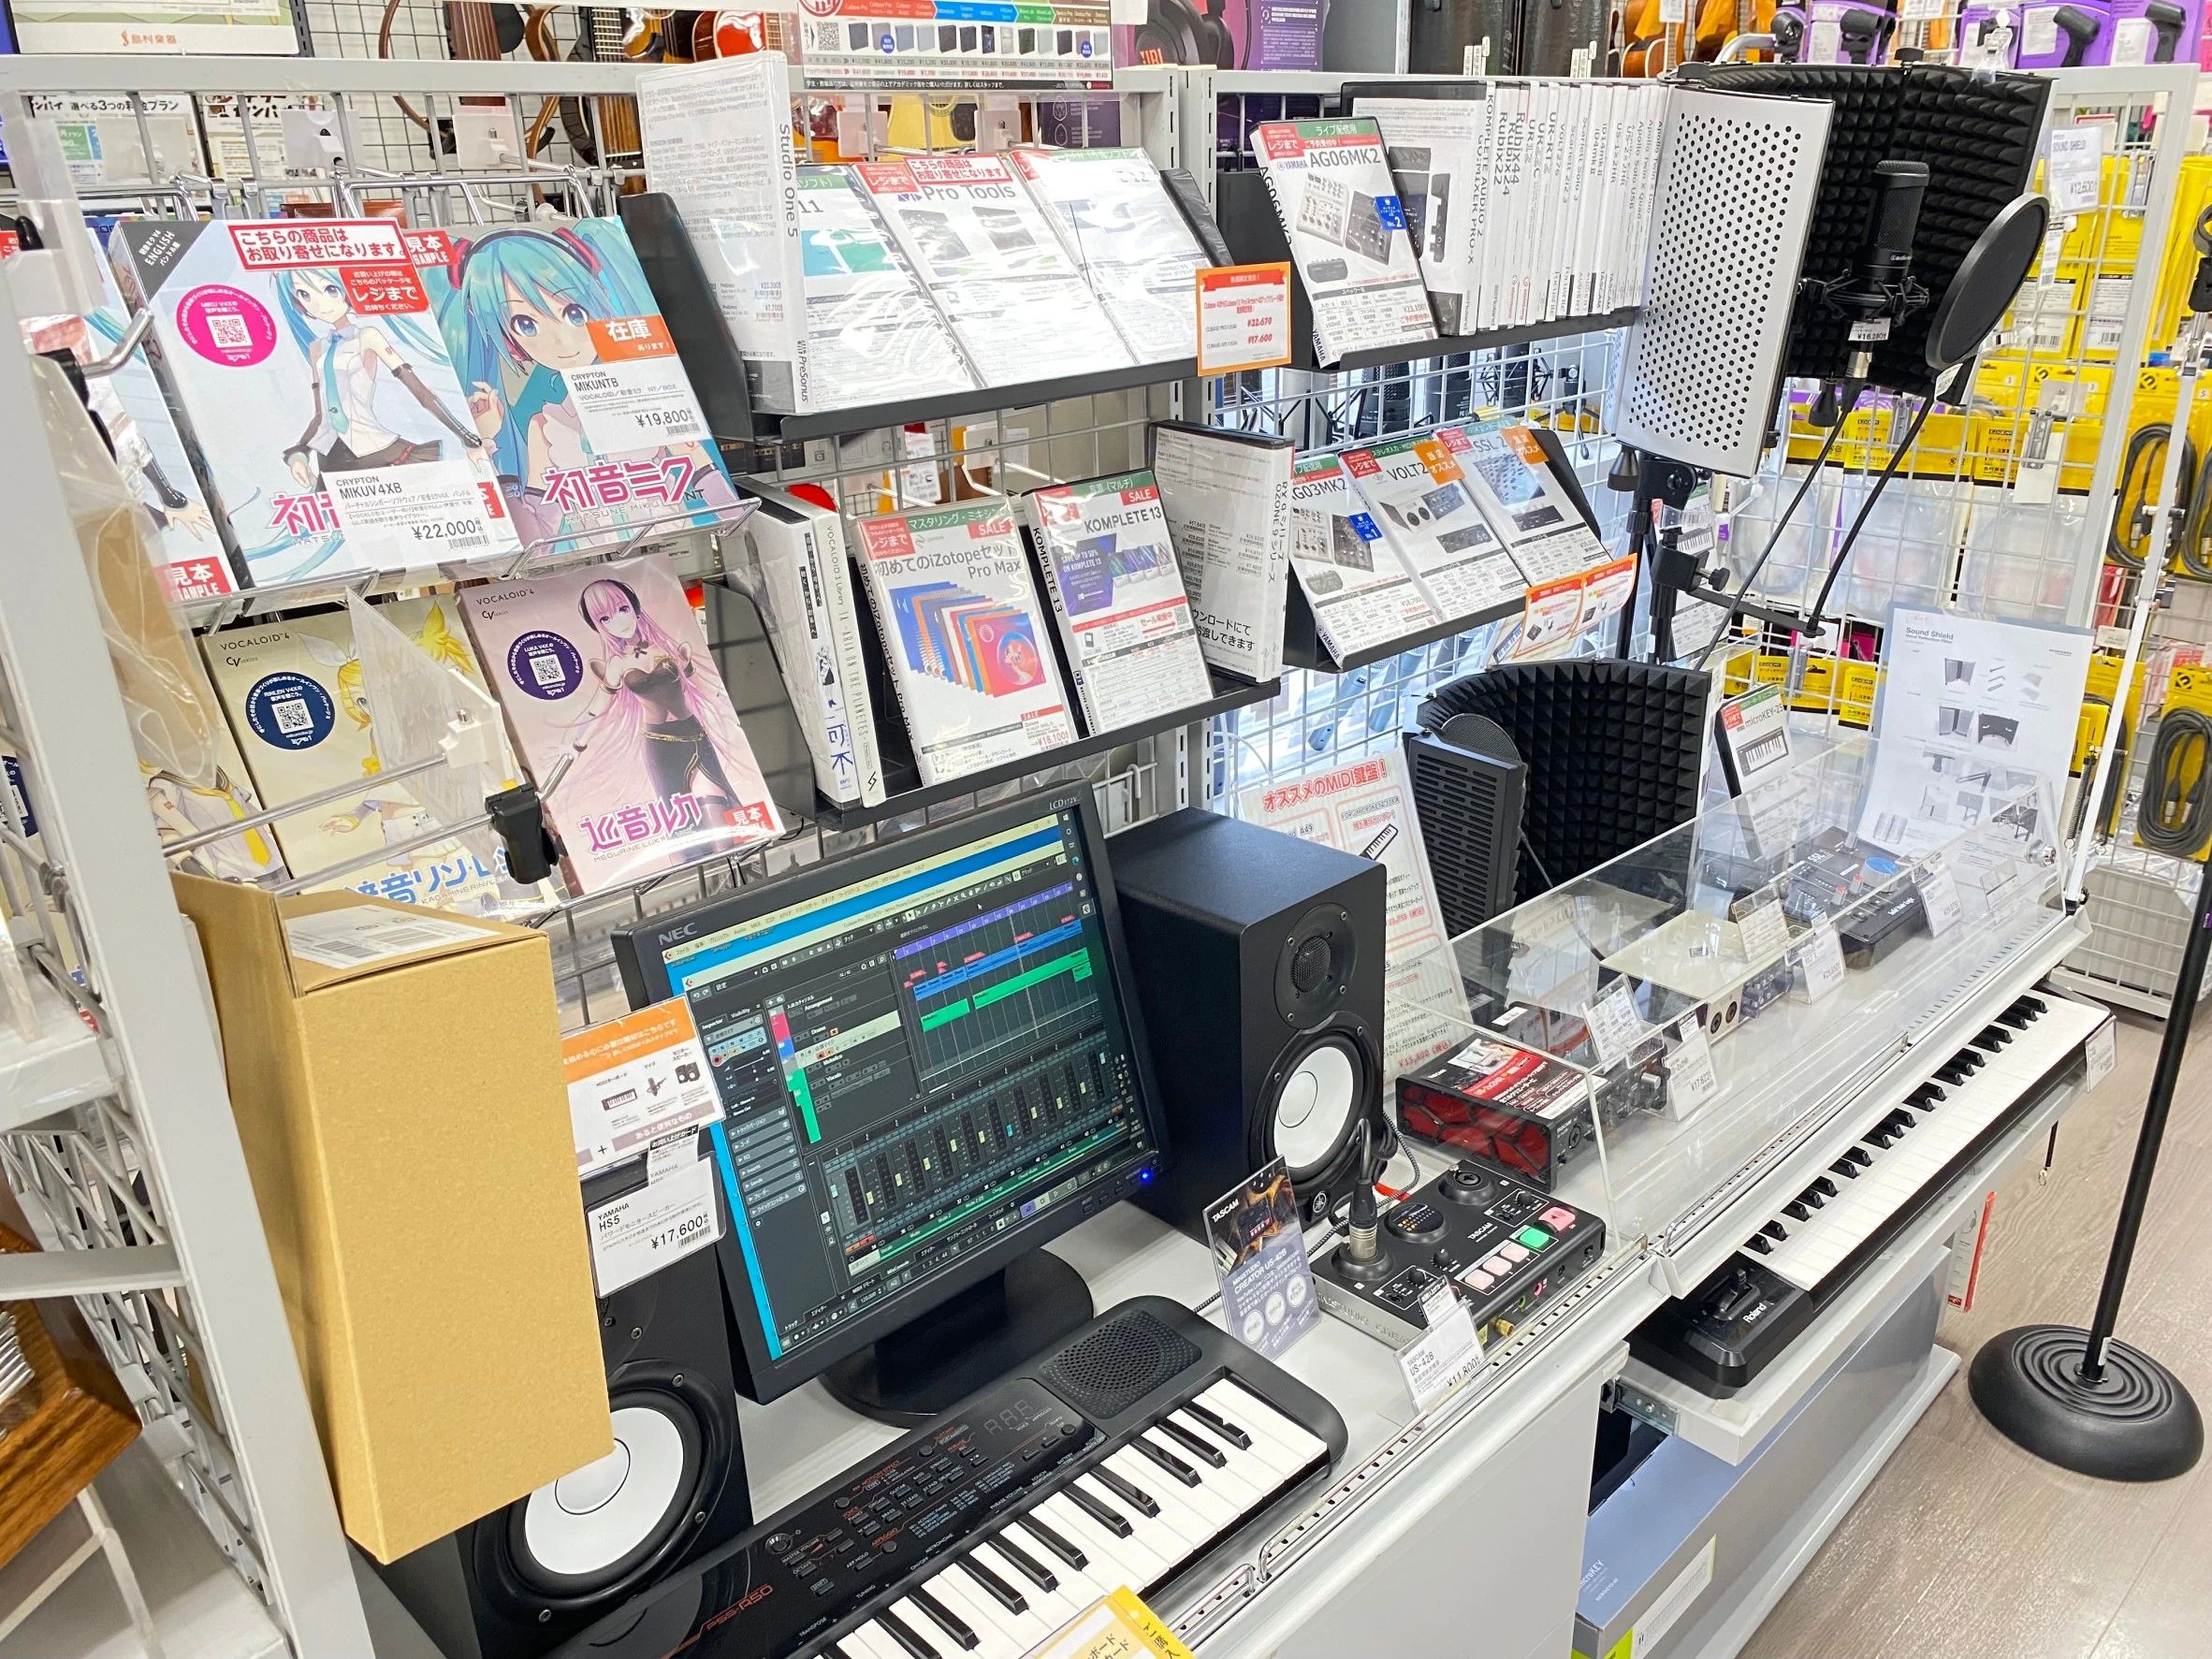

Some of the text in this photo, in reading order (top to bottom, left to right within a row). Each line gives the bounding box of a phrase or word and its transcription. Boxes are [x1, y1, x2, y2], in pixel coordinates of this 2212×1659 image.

[1268, 140, 1300, 152] レジまで
[1310, 148, 1381, 168] AG06MK2
[779, 124, 793, 182] Studio
[786, 187, 796, 221] One
[923, 183, 1018, 201] Pro Tools
[241, 226, 347, 245] こちらの商品は
[409, 234, 443, 253] 見本
[144, 230, 176, 267] ENGLISH
[247, 242, 405, 263] お取り寄せになります。
[353, 285, 418, 303] レジまで
[604, 318, 652, 342] 在庫
[1312, 328, 1326, 361] YAMAHA
[571, 371, 606, 381] CRYPTON
[574, 377, 619, 392] MIKUNTB
[798, 357, 808, 402] PreSonus
[635, 409, 689, 428] ¥19,800
[1474, 440, 1497, 453] SSL
[1351, 460, 1375, 473] レジまで
[1429, 460, 1457, 474] オススメ
[336, 475, 380, 488] CRYPTON
[339, 482, 402, 500] MIKUV4XB
[539, 454, 705, 515] 初音ミク NT
[1128, 489, 1152, 503] SALE
[978, 521, 1008, 536] SALE
[1084, 506, 1162, 533] KOMPLETE 13
[412, 519, 476, 541] ¥22,000
[826, 525, 840, 574] VOCALOID
[870, 533, 909, 550] レジまで
[968, 560, 1023, 580] Pro Max
[1033, 528, 1063, 614] KOMPLETE 13
[1268, 541, 1278, 583] シリーズ
[1905, 626, 1954, 641] Sound Shield
[1321, 633, 1340, 661] YAMAHA
[1745, 703, 1783, 727] microKEY-25
[1261, 758, 1389, 814] オススメのMIDI鍵盤!
[579, 793, 703, 852] 巡音ルカ
[732, 808, 763, 826] 見本
[593, 844, 644, 863] MEGURINE
[658, 923, 698, 946] NEC
[597, 1202, 631, 1219] YAMAHA
[1211, 1199, 1240, 1224] TASCAM
[599, 1215, 620, 1232] HS5
[650, 1215, 704, 1250] ¥17,600
[1467, 1221, 1494, 1241] TASCAM
[1234, 1267, 1266, 1295] CREATOR
[1742, 1302, 1768, 1325] Roland
[1408, 1350, 1435, 1377] US-42B
[925, 1533, 954, 1553] METRONOME
[910, 1556, 929, 1571] ON/OFF
[855, 1584, 877, 1600] TUNING
[706, 1584, 774, 1631] PSS-A50
[798, 1616, 828, 1638] TRANSPOSE
